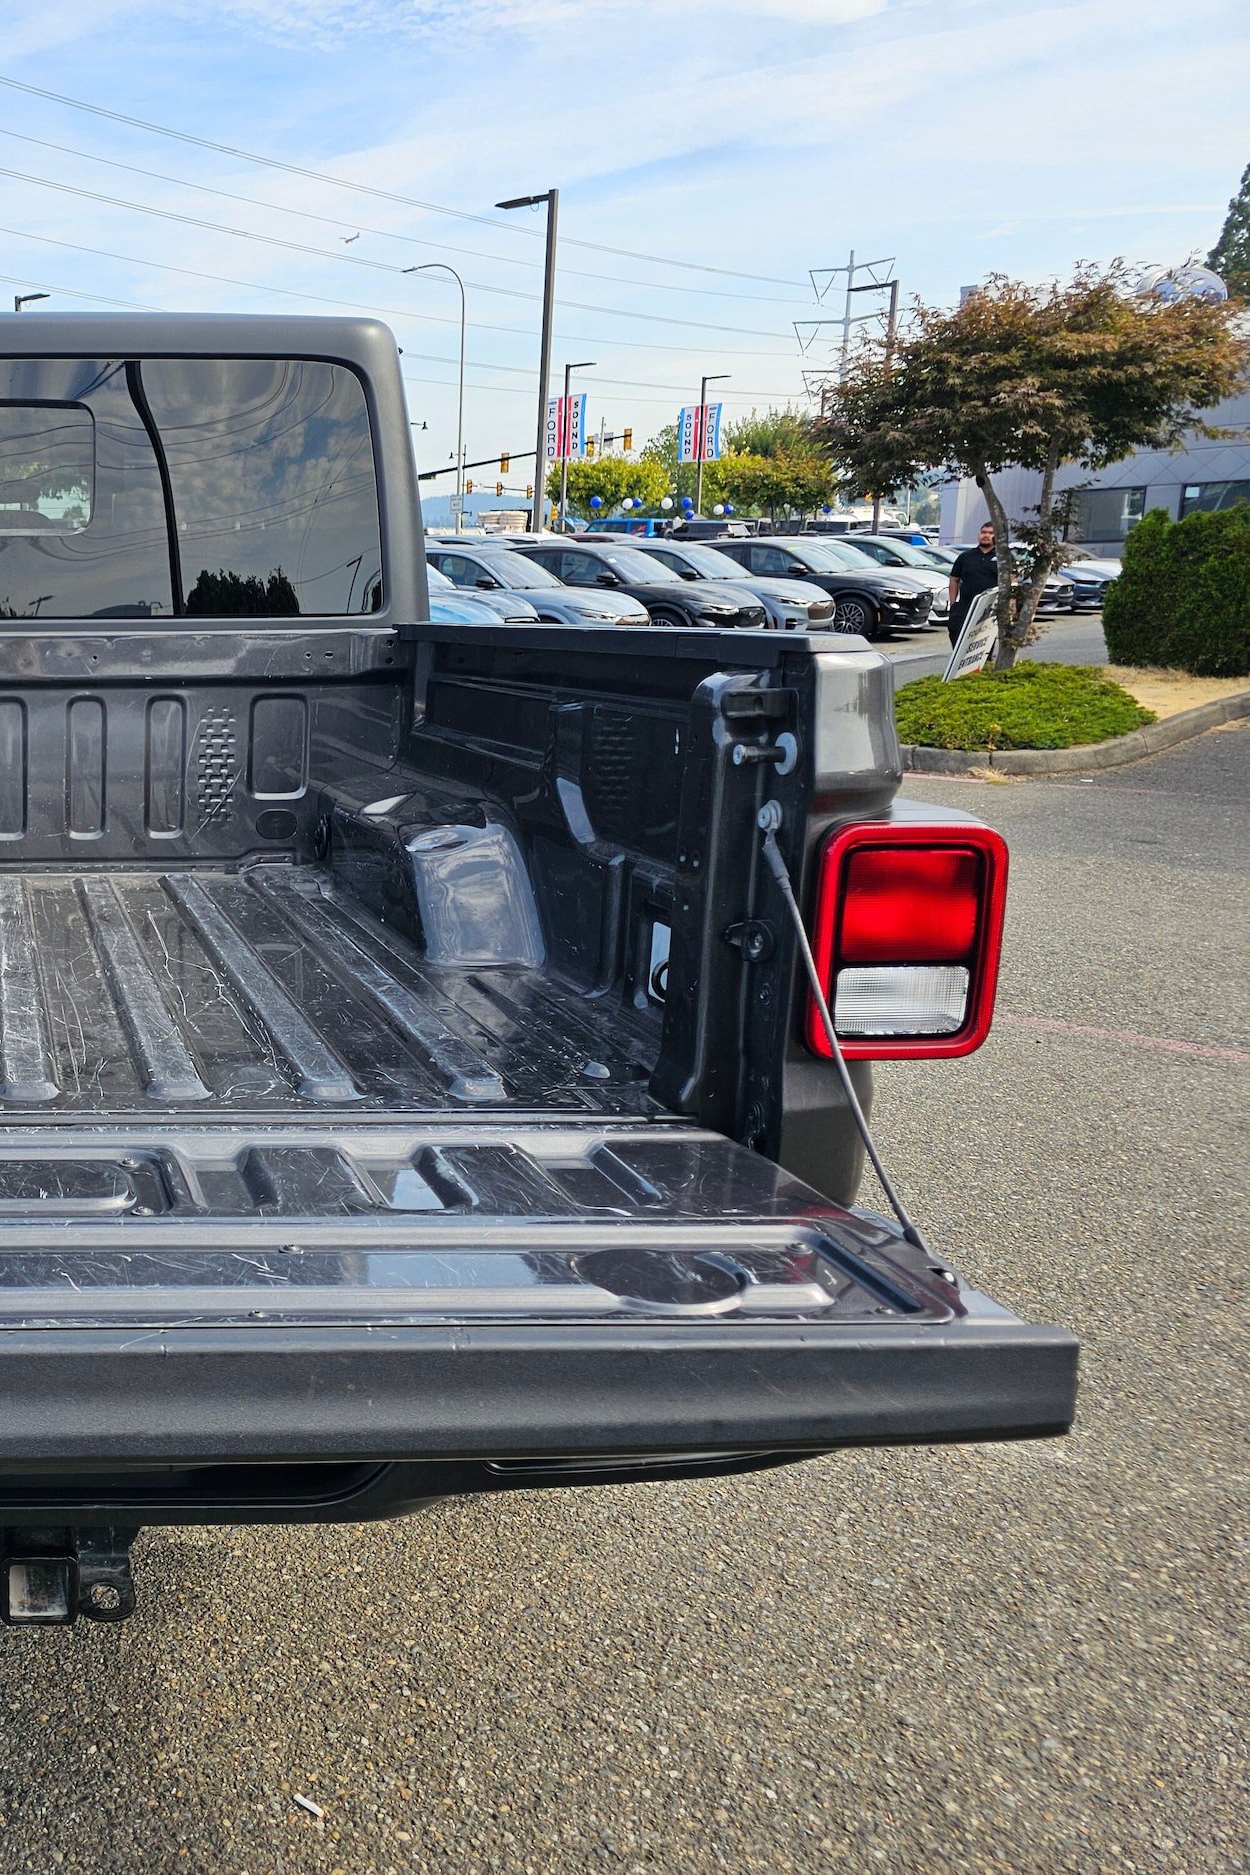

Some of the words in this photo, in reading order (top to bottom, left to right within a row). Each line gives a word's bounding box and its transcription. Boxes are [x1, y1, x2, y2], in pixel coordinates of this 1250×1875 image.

[547, 407, 556, 457] FORD
[684, 414, 692, 454] SOUND
[707, 412, 715, 458] FORD
